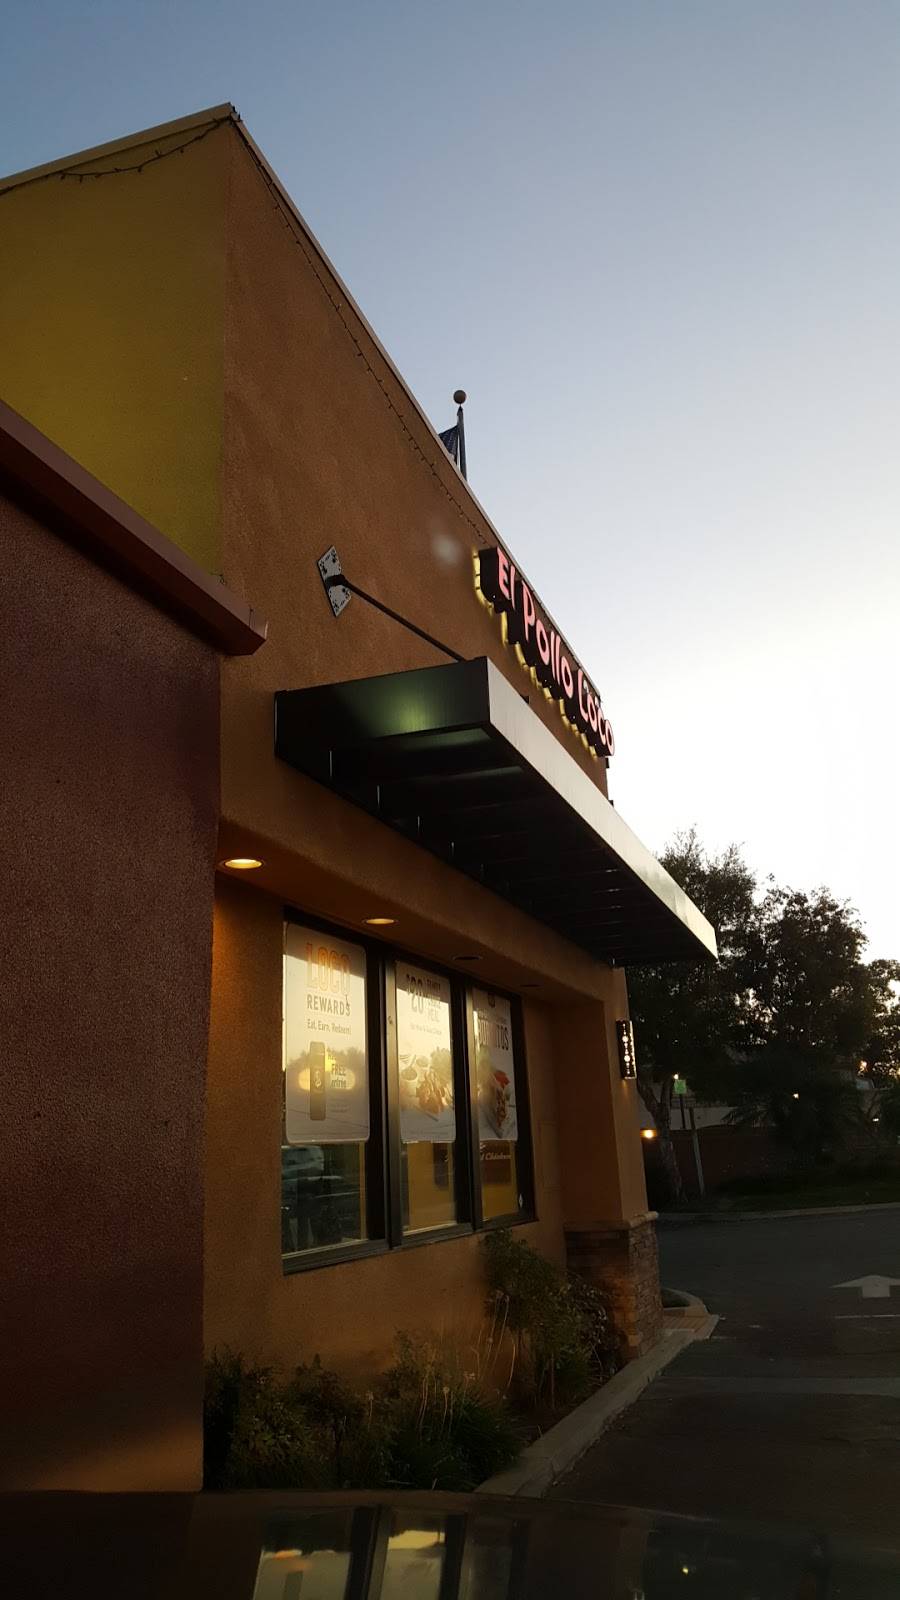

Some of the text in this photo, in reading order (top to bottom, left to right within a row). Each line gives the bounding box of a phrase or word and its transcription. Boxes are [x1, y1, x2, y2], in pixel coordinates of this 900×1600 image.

[497, 547, 615, 757] El Pollo Loco
[306, 942, 351, 994] LOCO
[307, 994, 351, 1017] REWARDS
